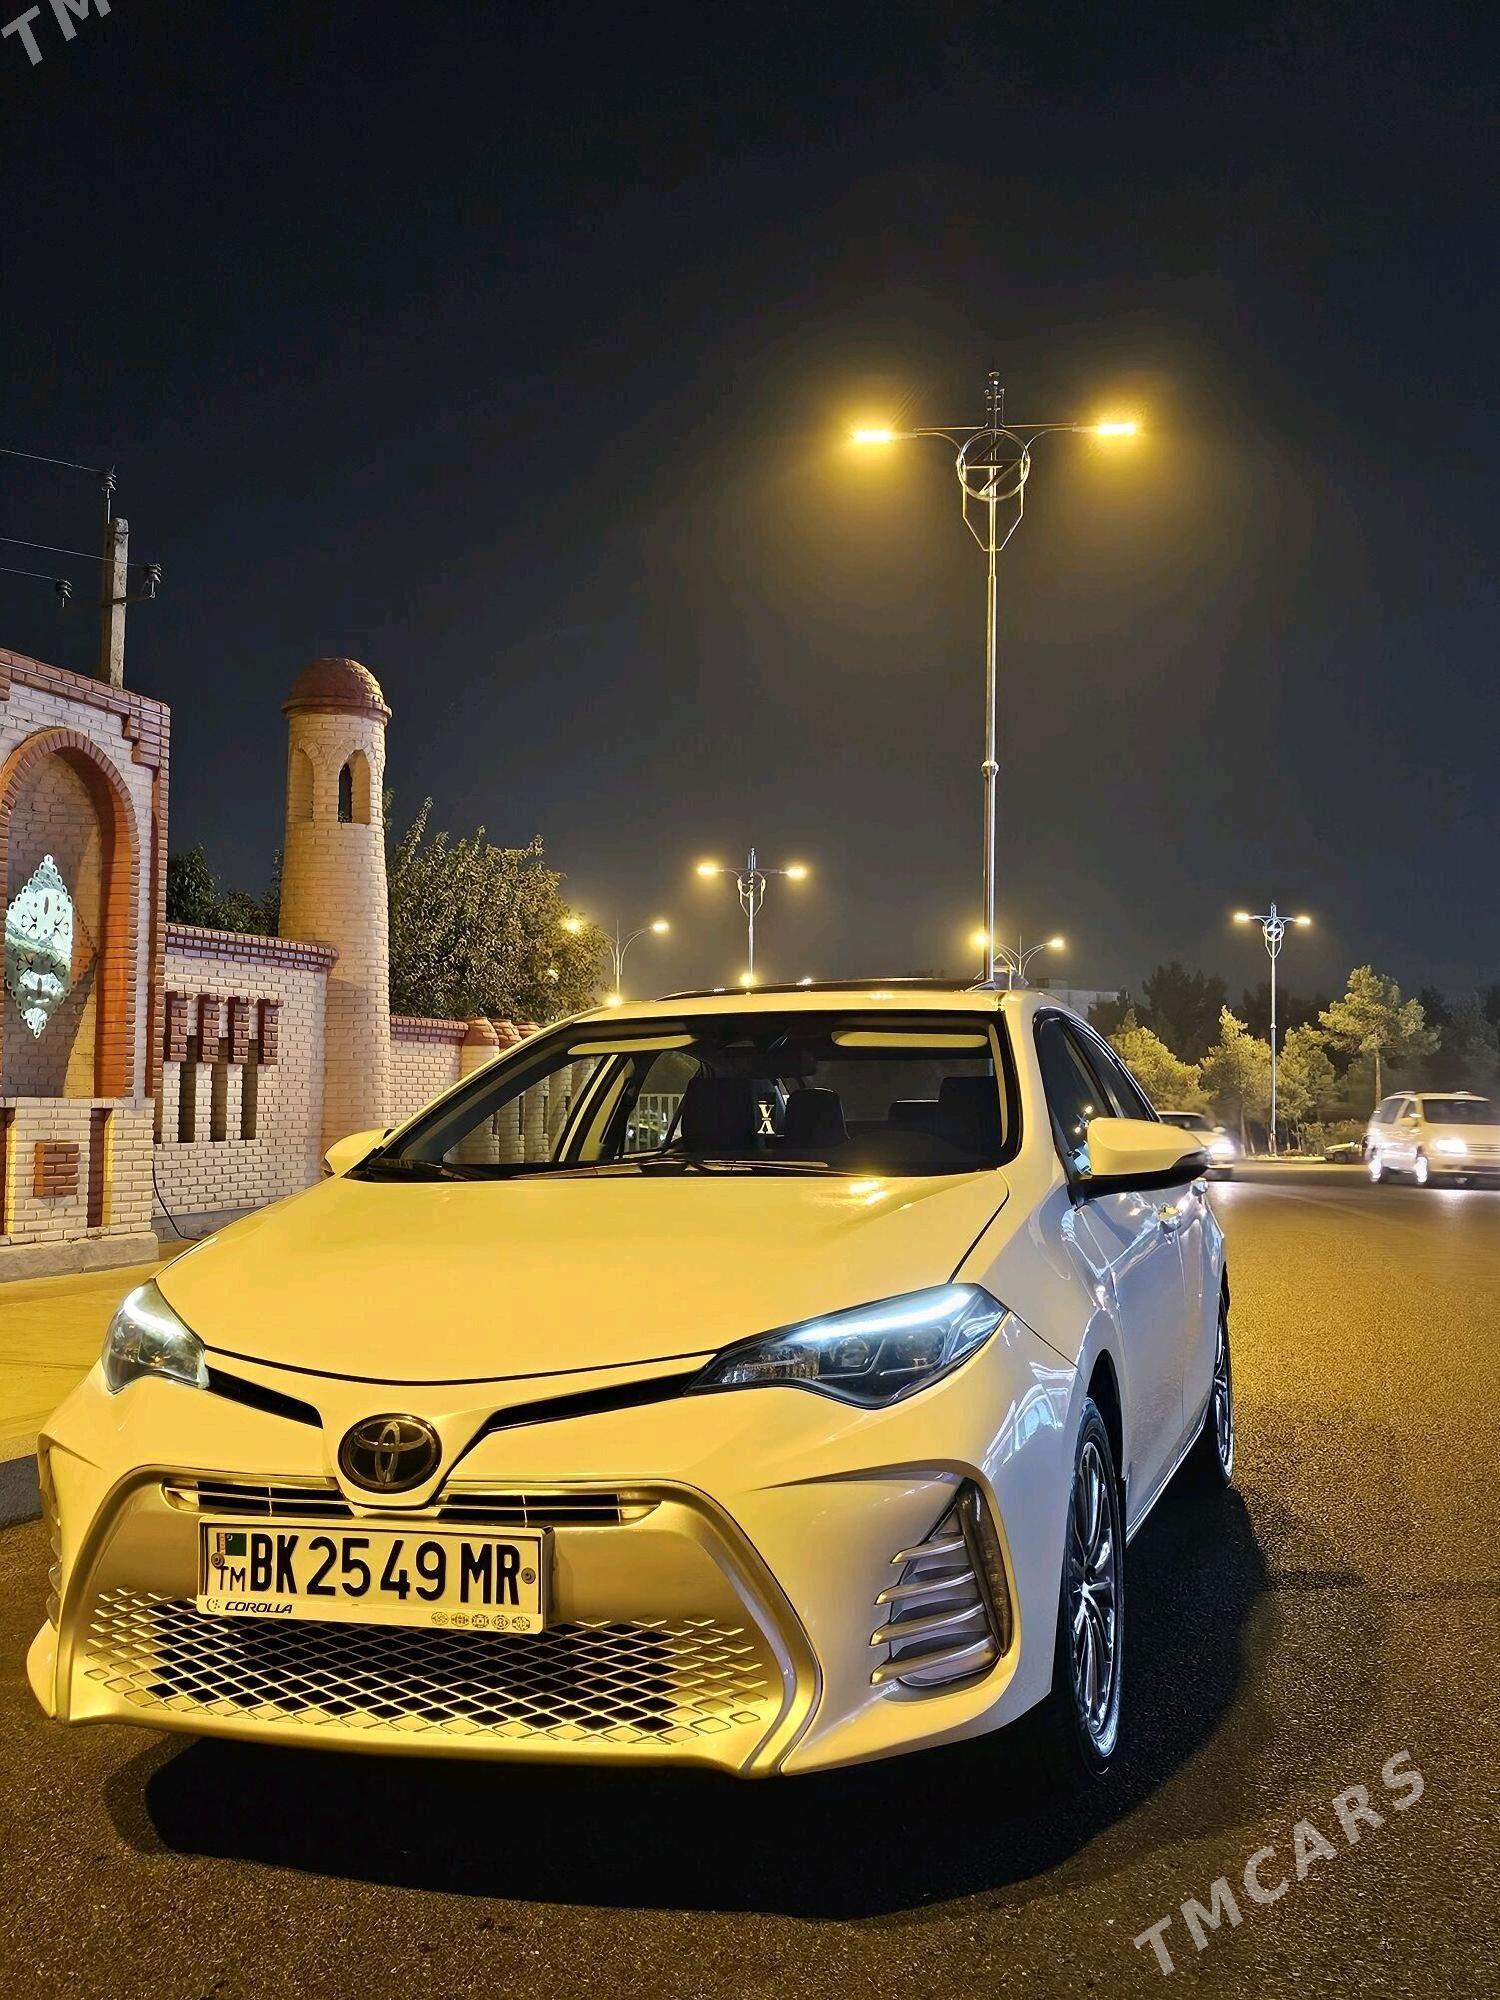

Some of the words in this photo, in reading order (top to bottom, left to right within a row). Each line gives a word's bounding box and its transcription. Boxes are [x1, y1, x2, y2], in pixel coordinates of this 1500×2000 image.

[219, 1565, 246, 1592] TM
[250, 1533, 299, 1594] BK
[306, 1535, 447, 1601] 2549
[460, 1542, 520, 1605] MR
[224, 1601, 293, 1615] COROLLA
